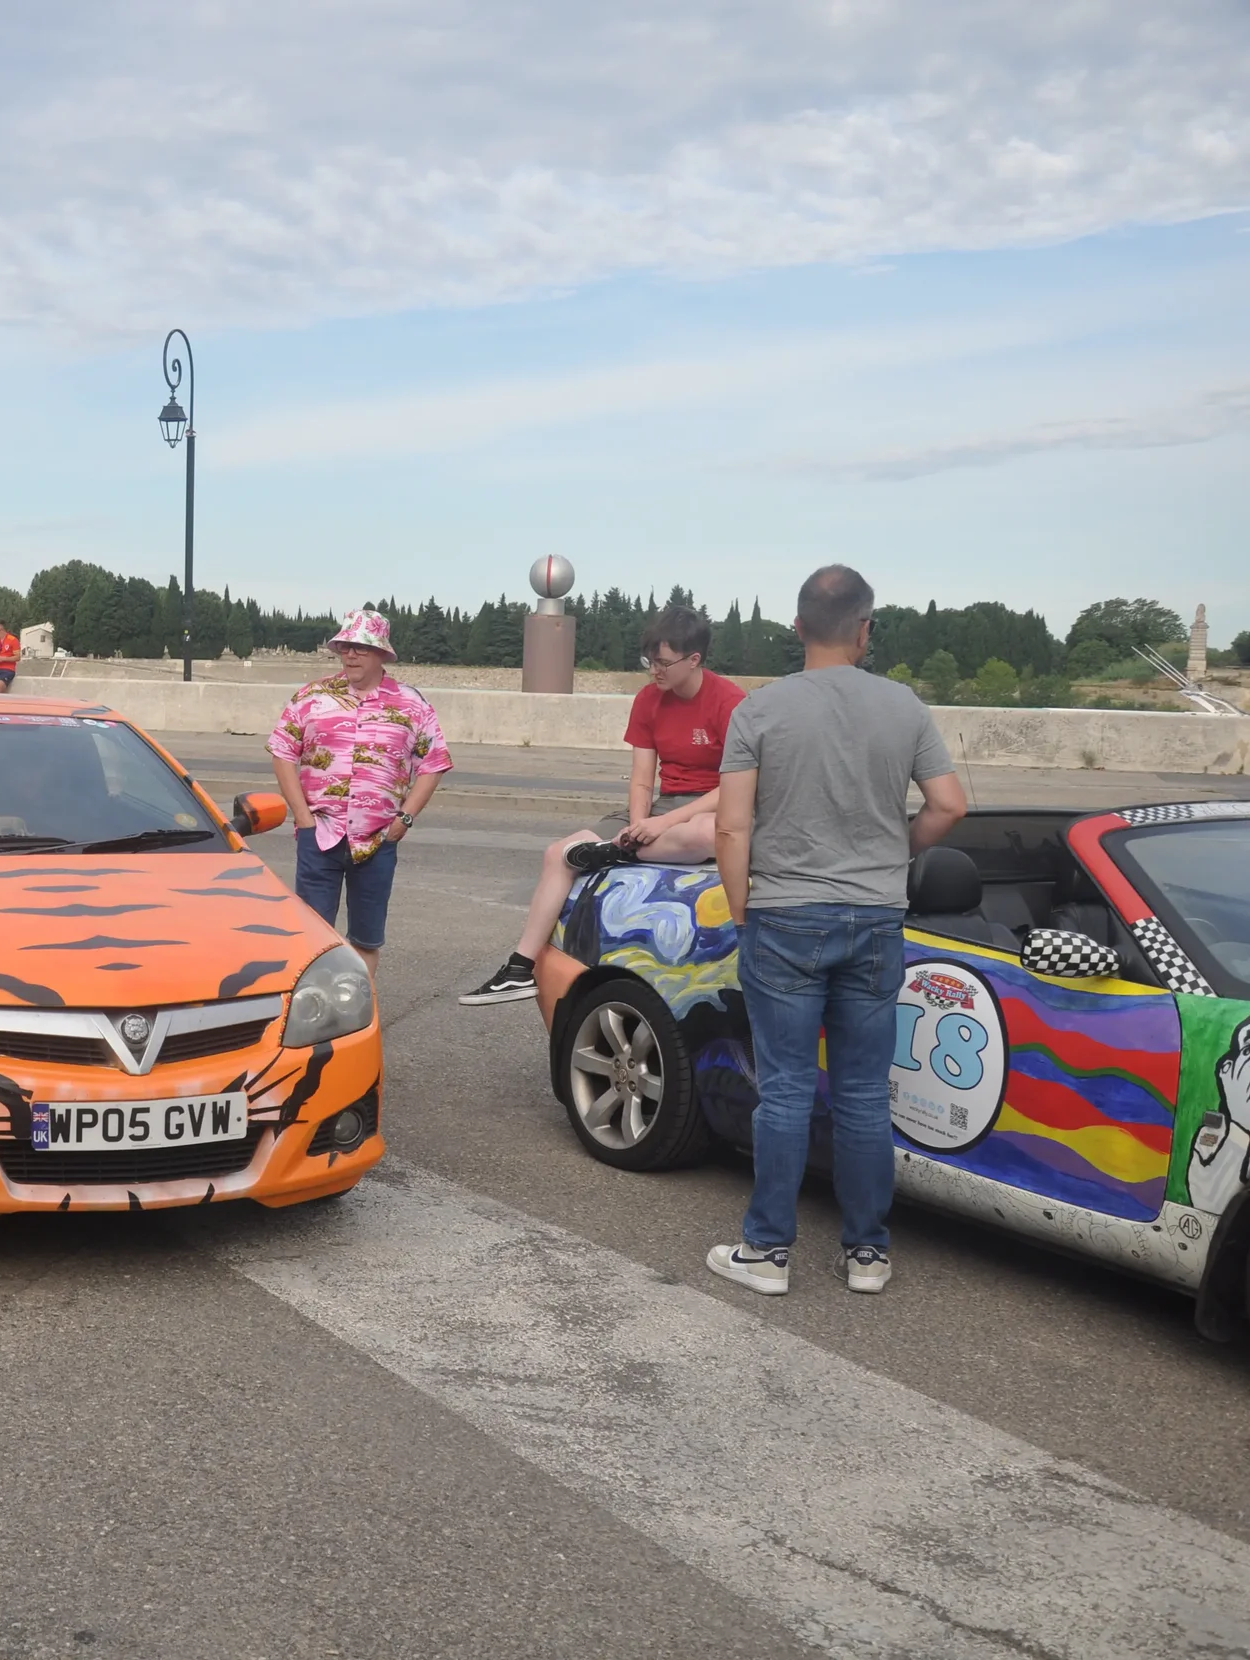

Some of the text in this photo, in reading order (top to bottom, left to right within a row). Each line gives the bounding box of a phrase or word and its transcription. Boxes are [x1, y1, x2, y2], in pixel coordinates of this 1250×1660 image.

[921, 979, 967, 1000] Wacky Rally
[50, 1100, 231, 1143] WP05 GVW
[33, 1131, 48, 1143] UK
[857, 1250, 873, 1259] NIKE
